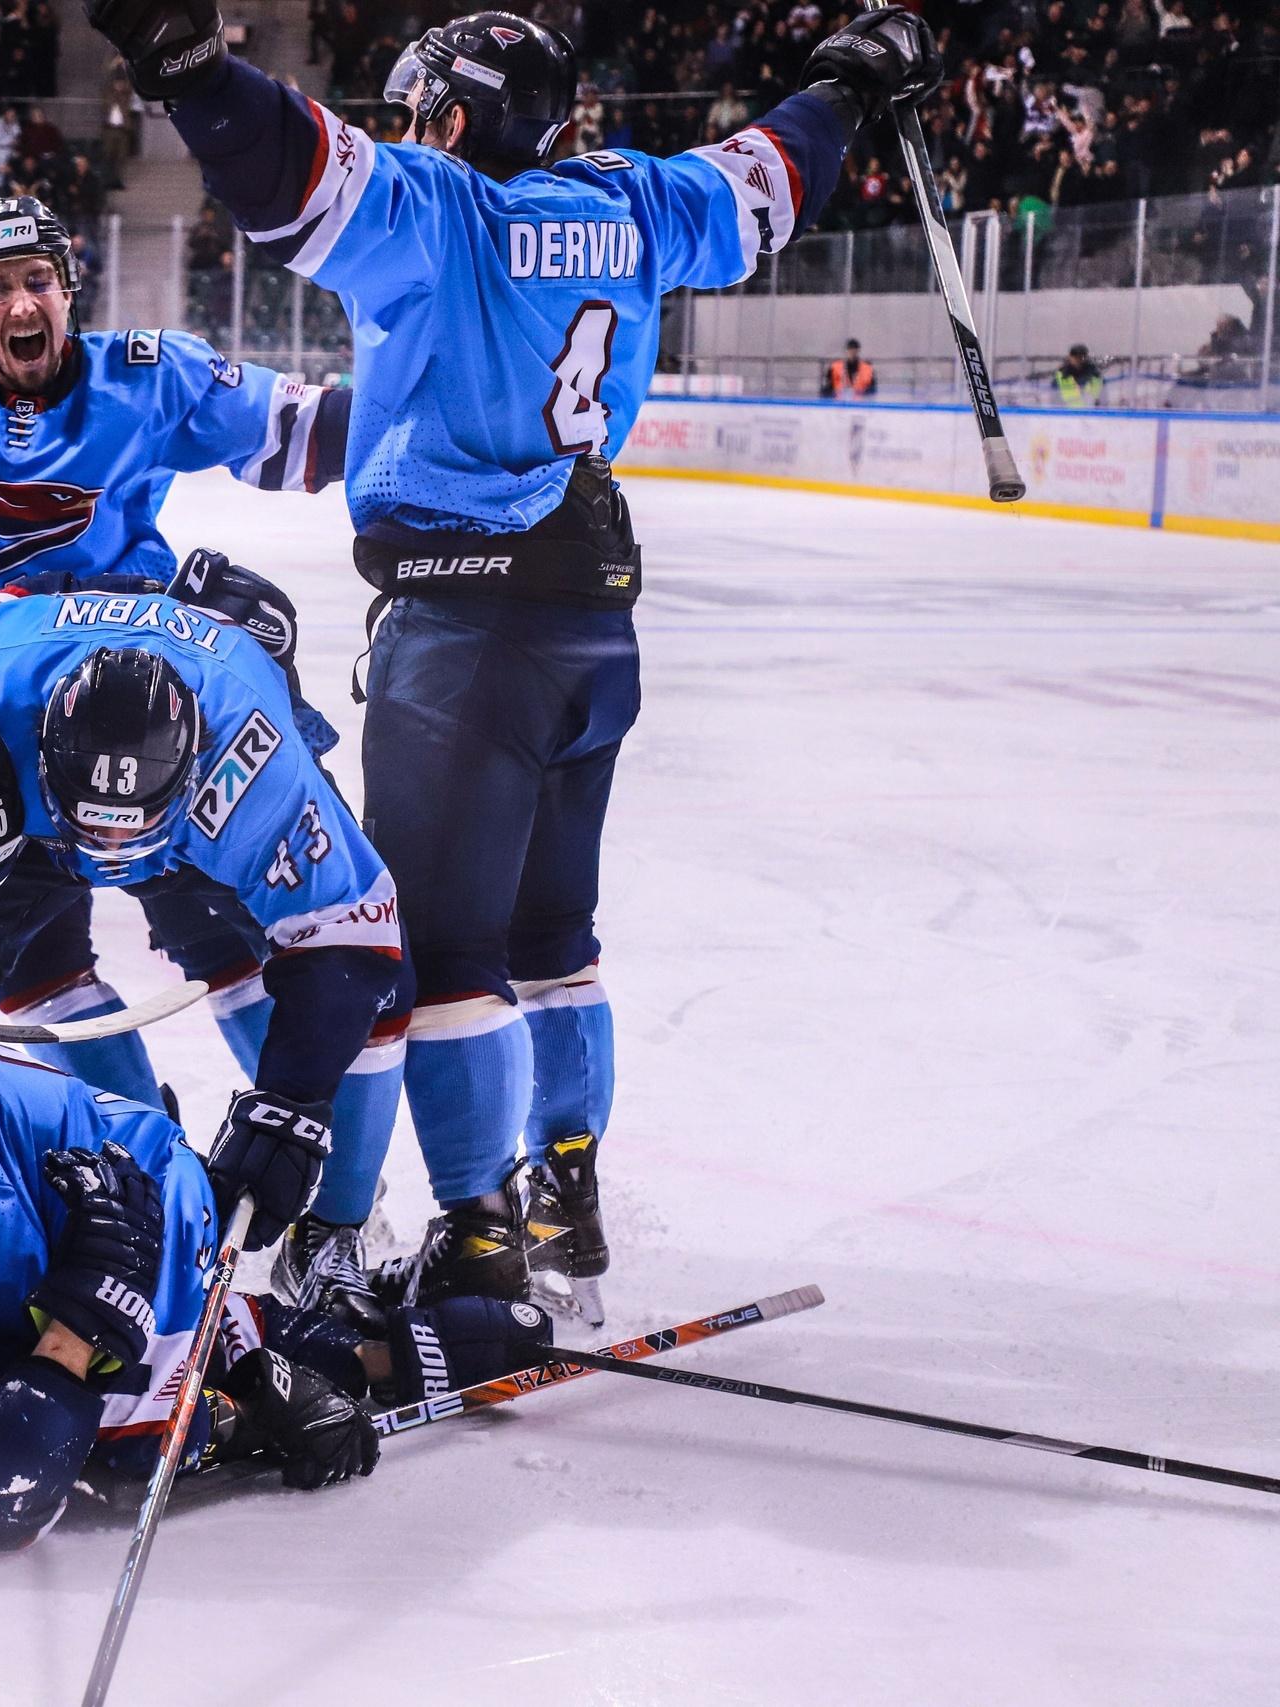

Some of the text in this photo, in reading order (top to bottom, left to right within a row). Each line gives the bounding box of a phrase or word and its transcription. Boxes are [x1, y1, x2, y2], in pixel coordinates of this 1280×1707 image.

[541, 299, 618, 456] 4
[397, 556, 513, 580] BAUER
[54, 597, 221, 654] TSYBIN
[247, 617, 281, 633] CCM
[90, 754, 138, 796] 43
[192, 716, 277, 835] PARI
[82, 809, 139, 824] PARI
[264, 799, 332, 892] 43
[95, 1275, 157, 1340] RIOR
[702, 1307, 760, 1331] TRUE
[409, 1323, 450, 1402] RIOR
[513, 1342, 638, 1393] HZRDS 9X
[370, 1392, 465, 1437] RUE
